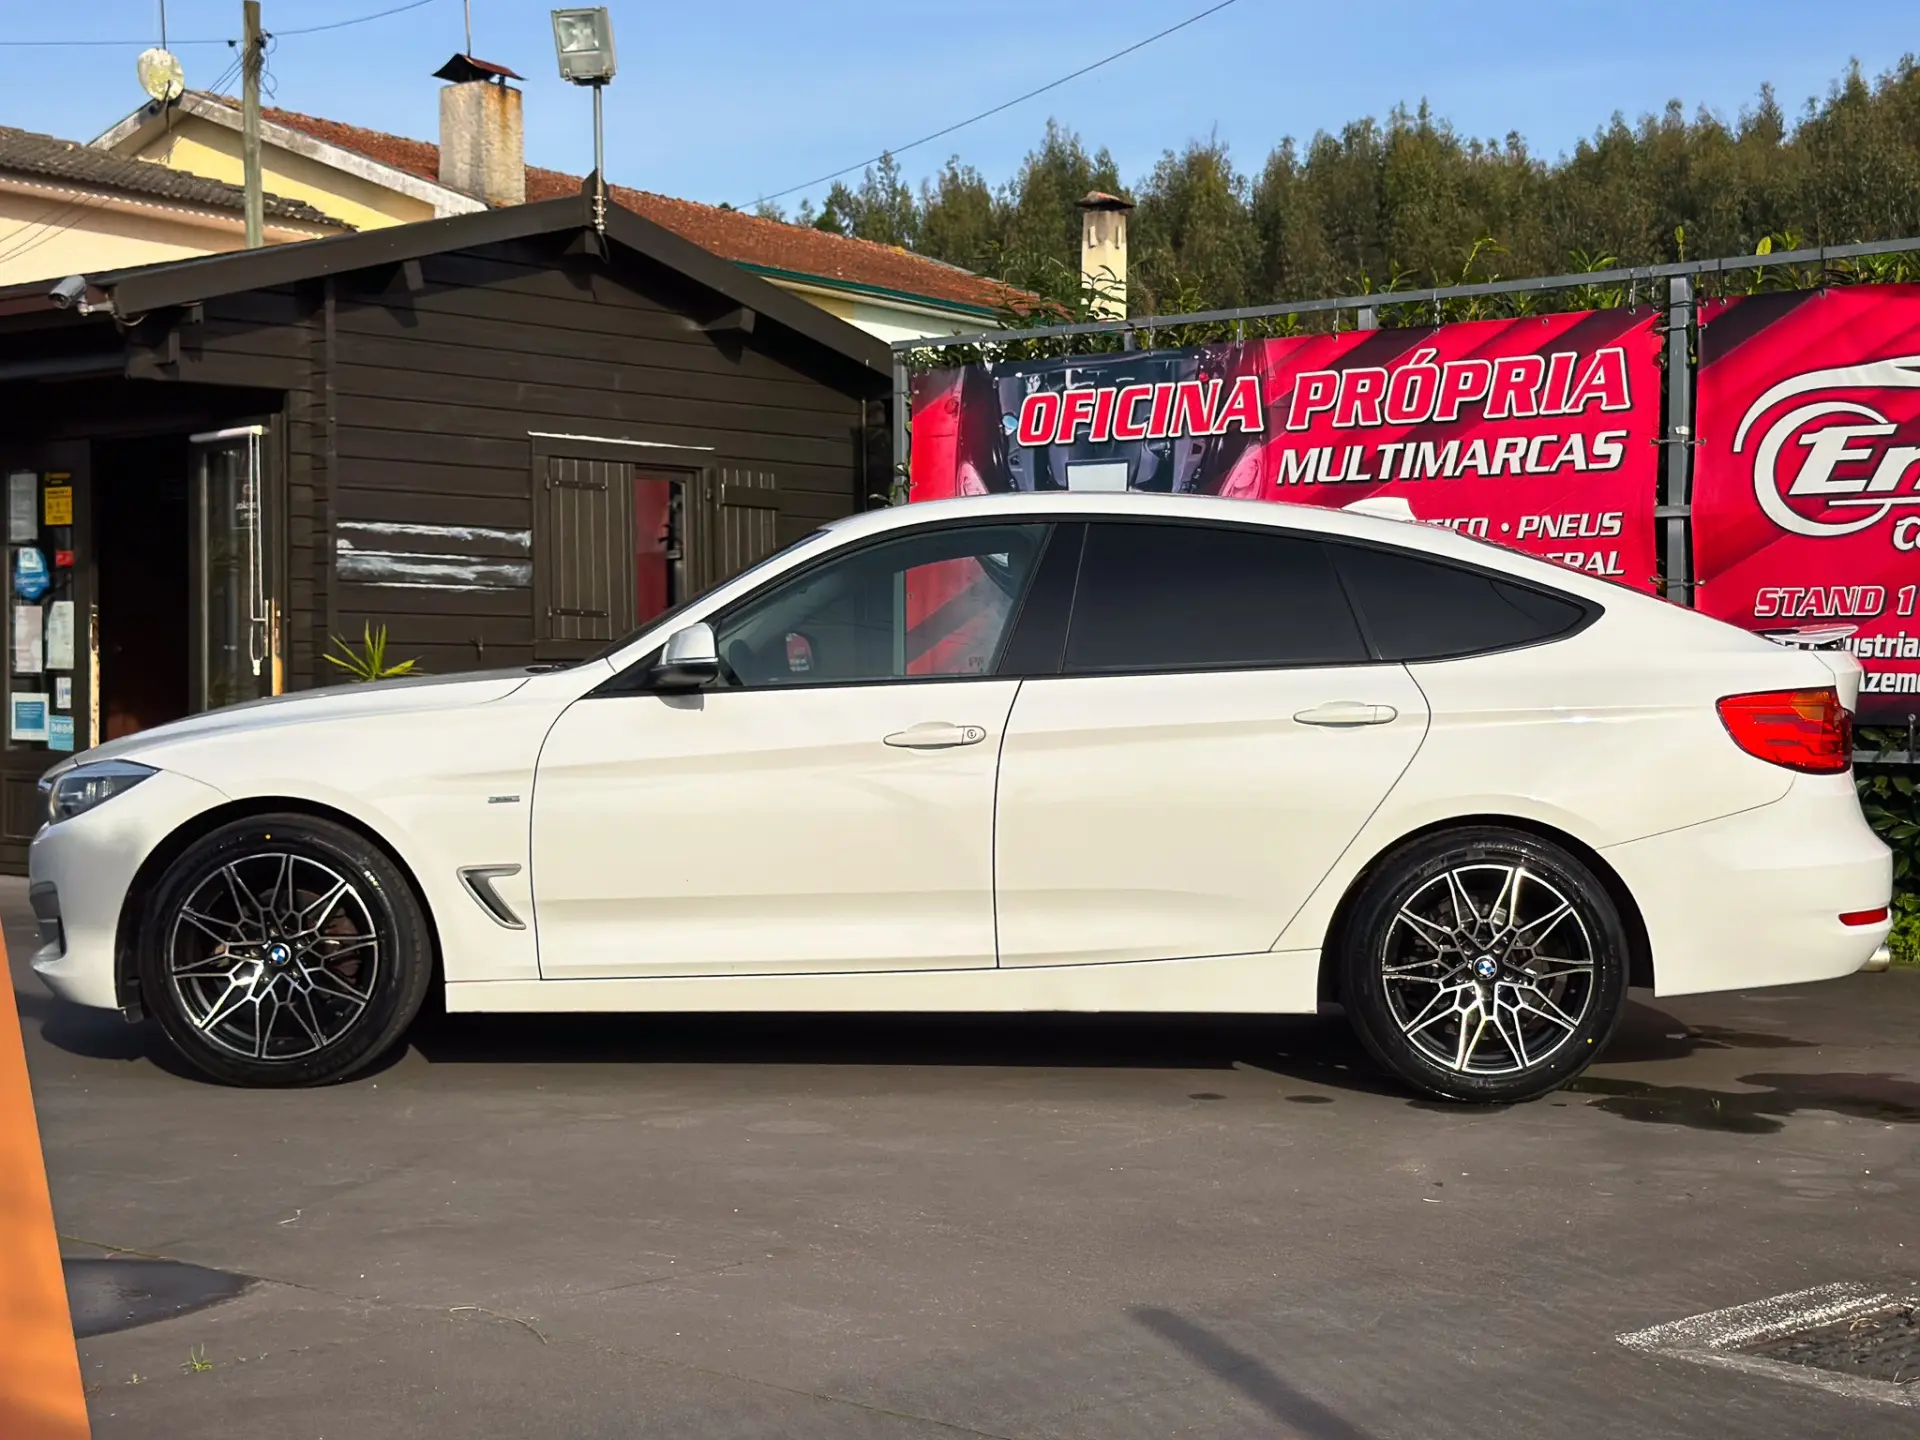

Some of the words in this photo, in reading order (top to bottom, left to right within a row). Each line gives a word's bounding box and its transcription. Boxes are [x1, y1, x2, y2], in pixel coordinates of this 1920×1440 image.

[1016, 376, 1264, 446] OFICINA
[1286, 347, 1632, 430] PRÓPRIA
[1276, 430, 1627, 484] MULTIMARCAS
[1516, 512, 1623, 539] PNEUS
[1754, 586, 1885, 617] STAND
